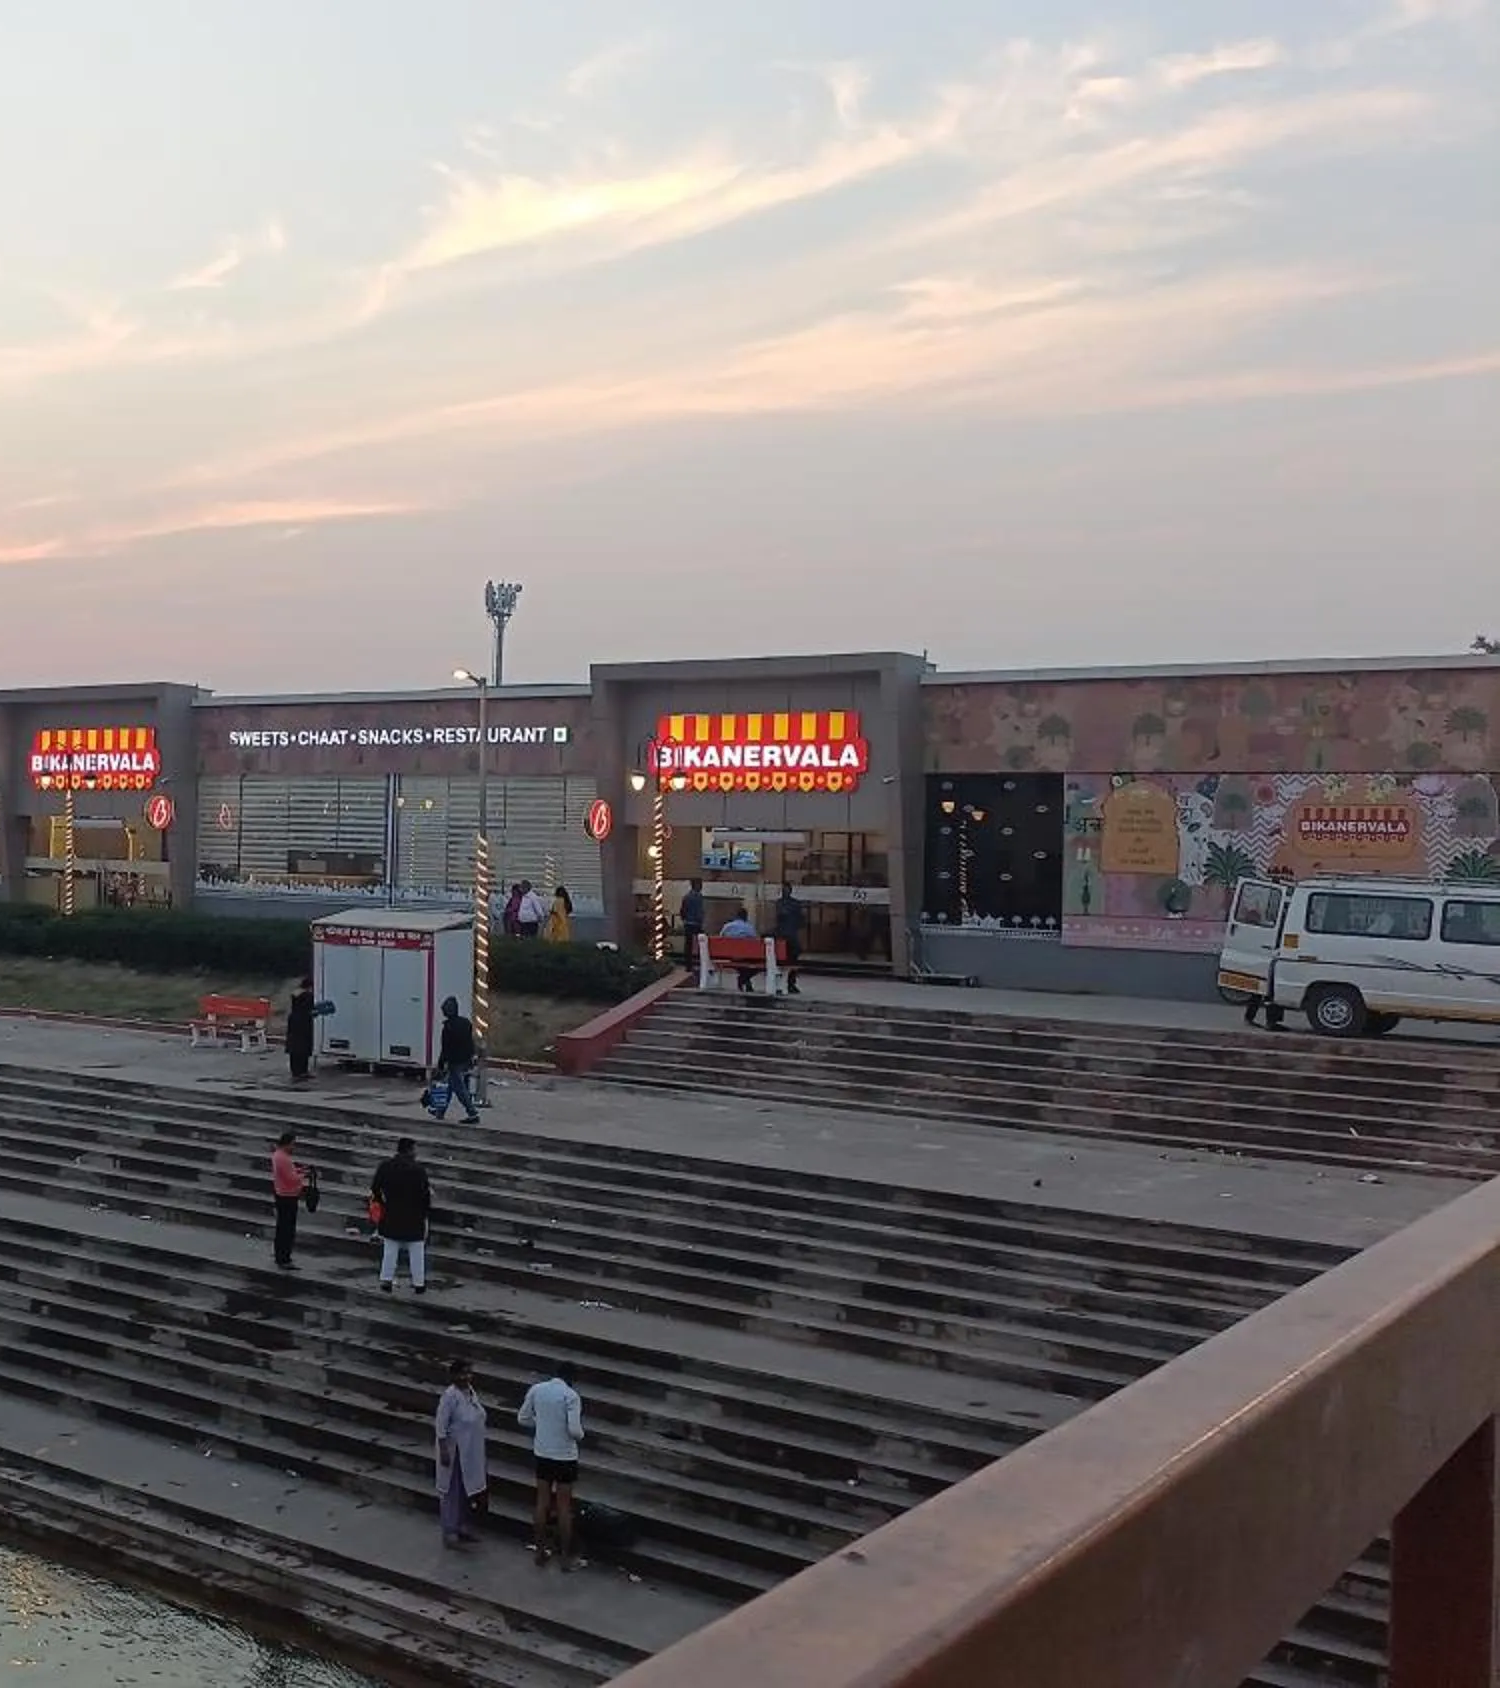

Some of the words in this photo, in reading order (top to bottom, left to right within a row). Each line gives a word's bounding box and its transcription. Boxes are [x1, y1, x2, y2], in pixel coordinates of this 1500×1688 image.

[229, 730, 289, 747] SWEETS
[298, 729, 349, 745] CHAAT
[358, 727, 424, 745] SNACKS
[654, 744, 859, 768] BIKANERVALA
[1301, 821, 1407, 833] BIKANERVALA
